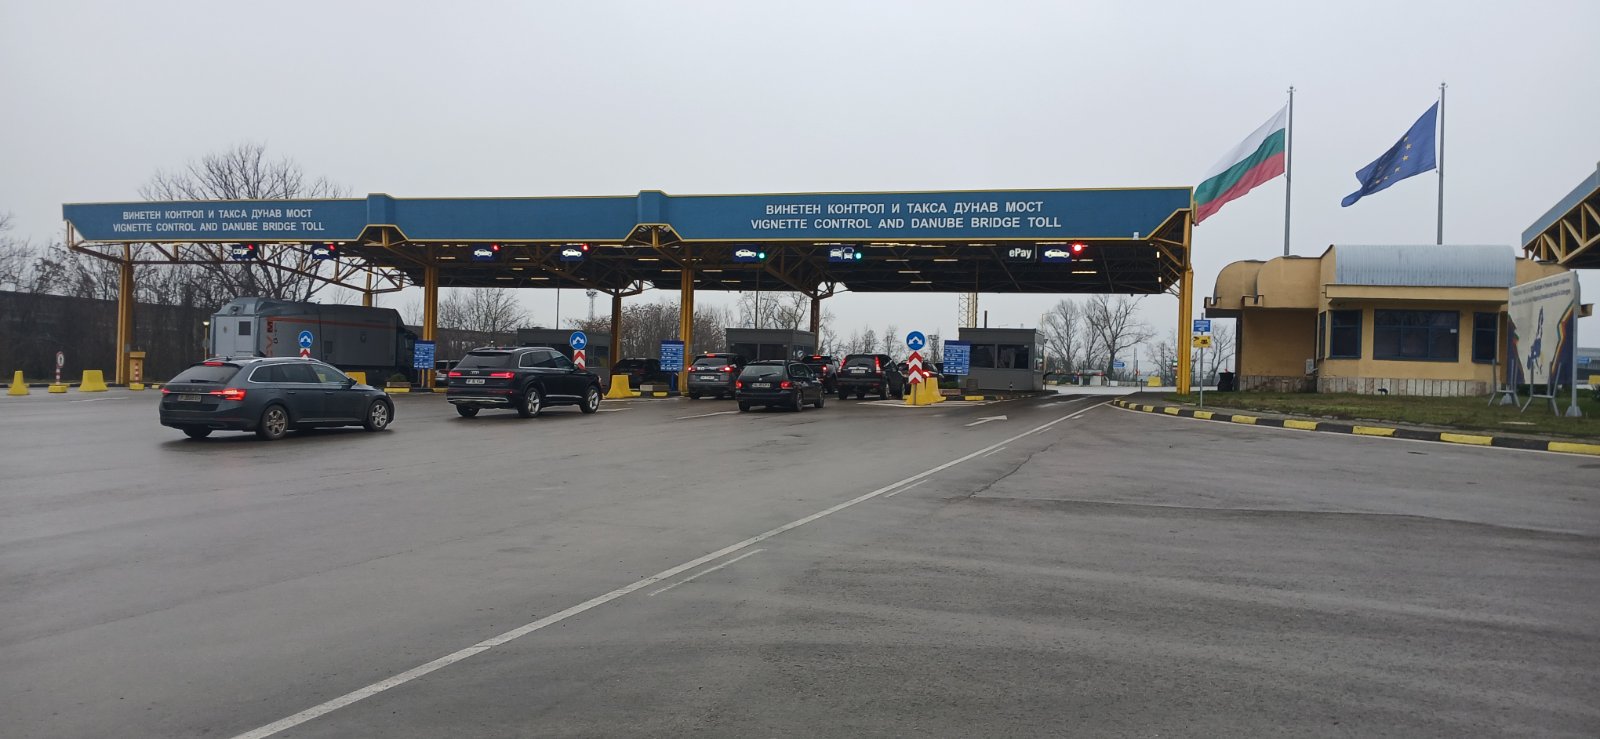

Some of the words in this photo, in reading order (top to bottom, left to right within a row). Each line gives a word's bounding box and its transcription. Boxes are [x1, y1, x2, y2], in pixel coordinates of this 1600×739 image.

[122, 211, 161, 220] ВИНЕТЕН
[164, 210, 204, 219] КОНТРОЛ
[207, 210, 215, 219] И
[218, 209, 248, 218] ТАКСА
[251, 209, 282, 219] ДУНАВ
[286, 209, 313, 218] МОСТ
[766, 204, 821, 215] ВИНЕТЕН
[827, 203, 885, 214] КОНТРОЛ
[891, 203, 900, 214] И
[906, 202, 948, 213] ТАКСА
[953, 202, 999, 214] ДУНАВ
[1005, 201, 1044, 213] МОСТ
[112, 223, 153, 232] VIGNETTE
[156, 223, 197, 232] CONTROL
[199, 222, 218, 231] AND
[221, 222, 258, 231] DANUBE
[262, 222, 297, 231] BRIDGE
[301, 221, 325, 231] TOLL
[750, 218, 808, 230] VIGNETTE
[813, 218, 872, 229] CONTROL
[877, 218, 905, 229] AND
[911, 217, 964, 229] DANUBE
[970, 217, 1021, 228] BRIDGE
[1027, 216, 1062, 228] TOLL
[1008, 247, 1032, 260] ePay
